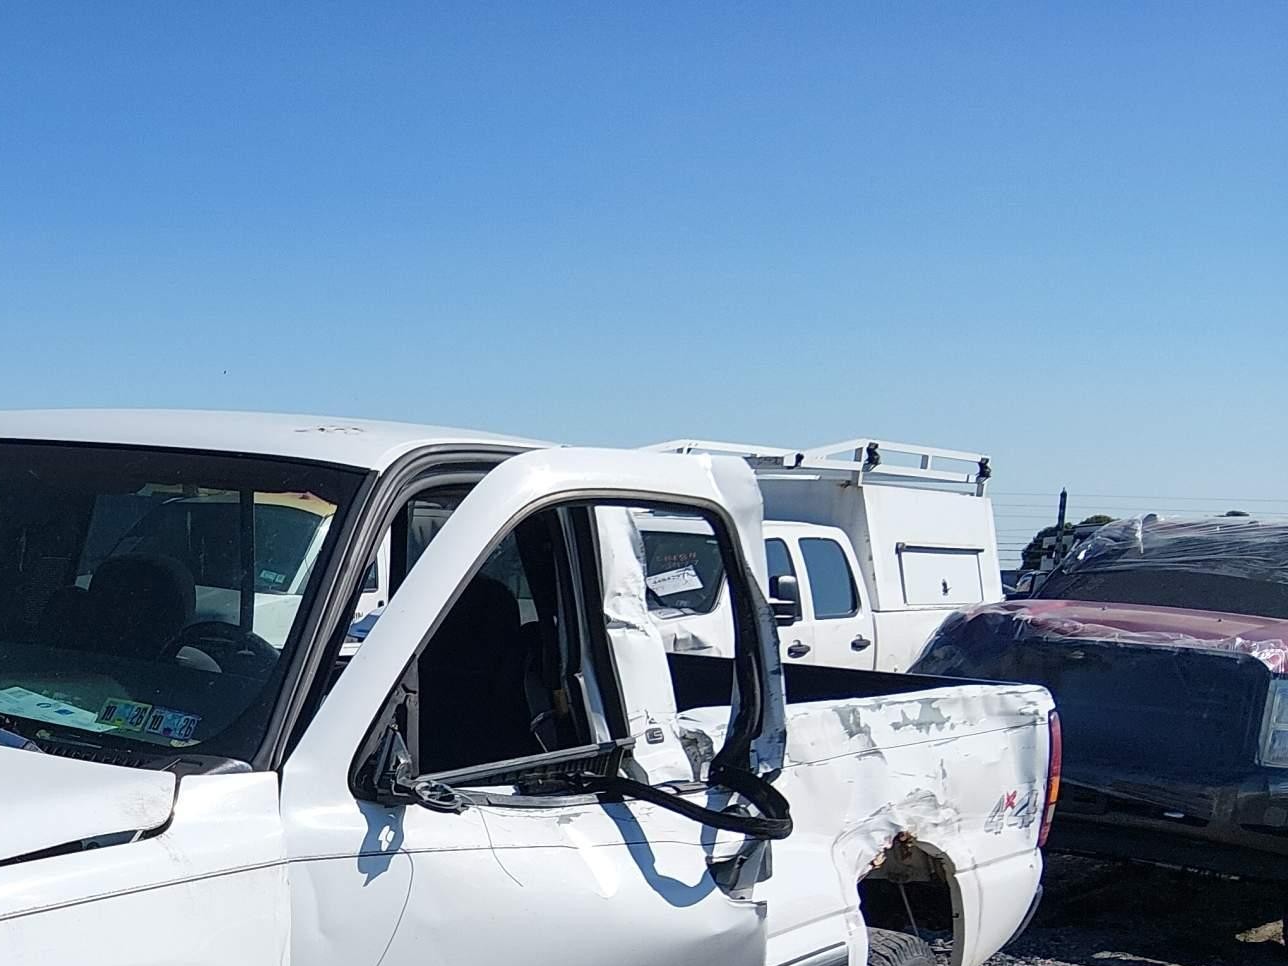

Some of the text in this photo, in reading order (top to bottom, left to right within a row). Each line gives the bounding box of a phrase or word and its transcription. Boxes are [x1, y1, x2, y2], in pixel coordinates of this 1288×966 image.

[102, 704, 148, 729] 10 26
[149, 714, 196, 738] 10 26
